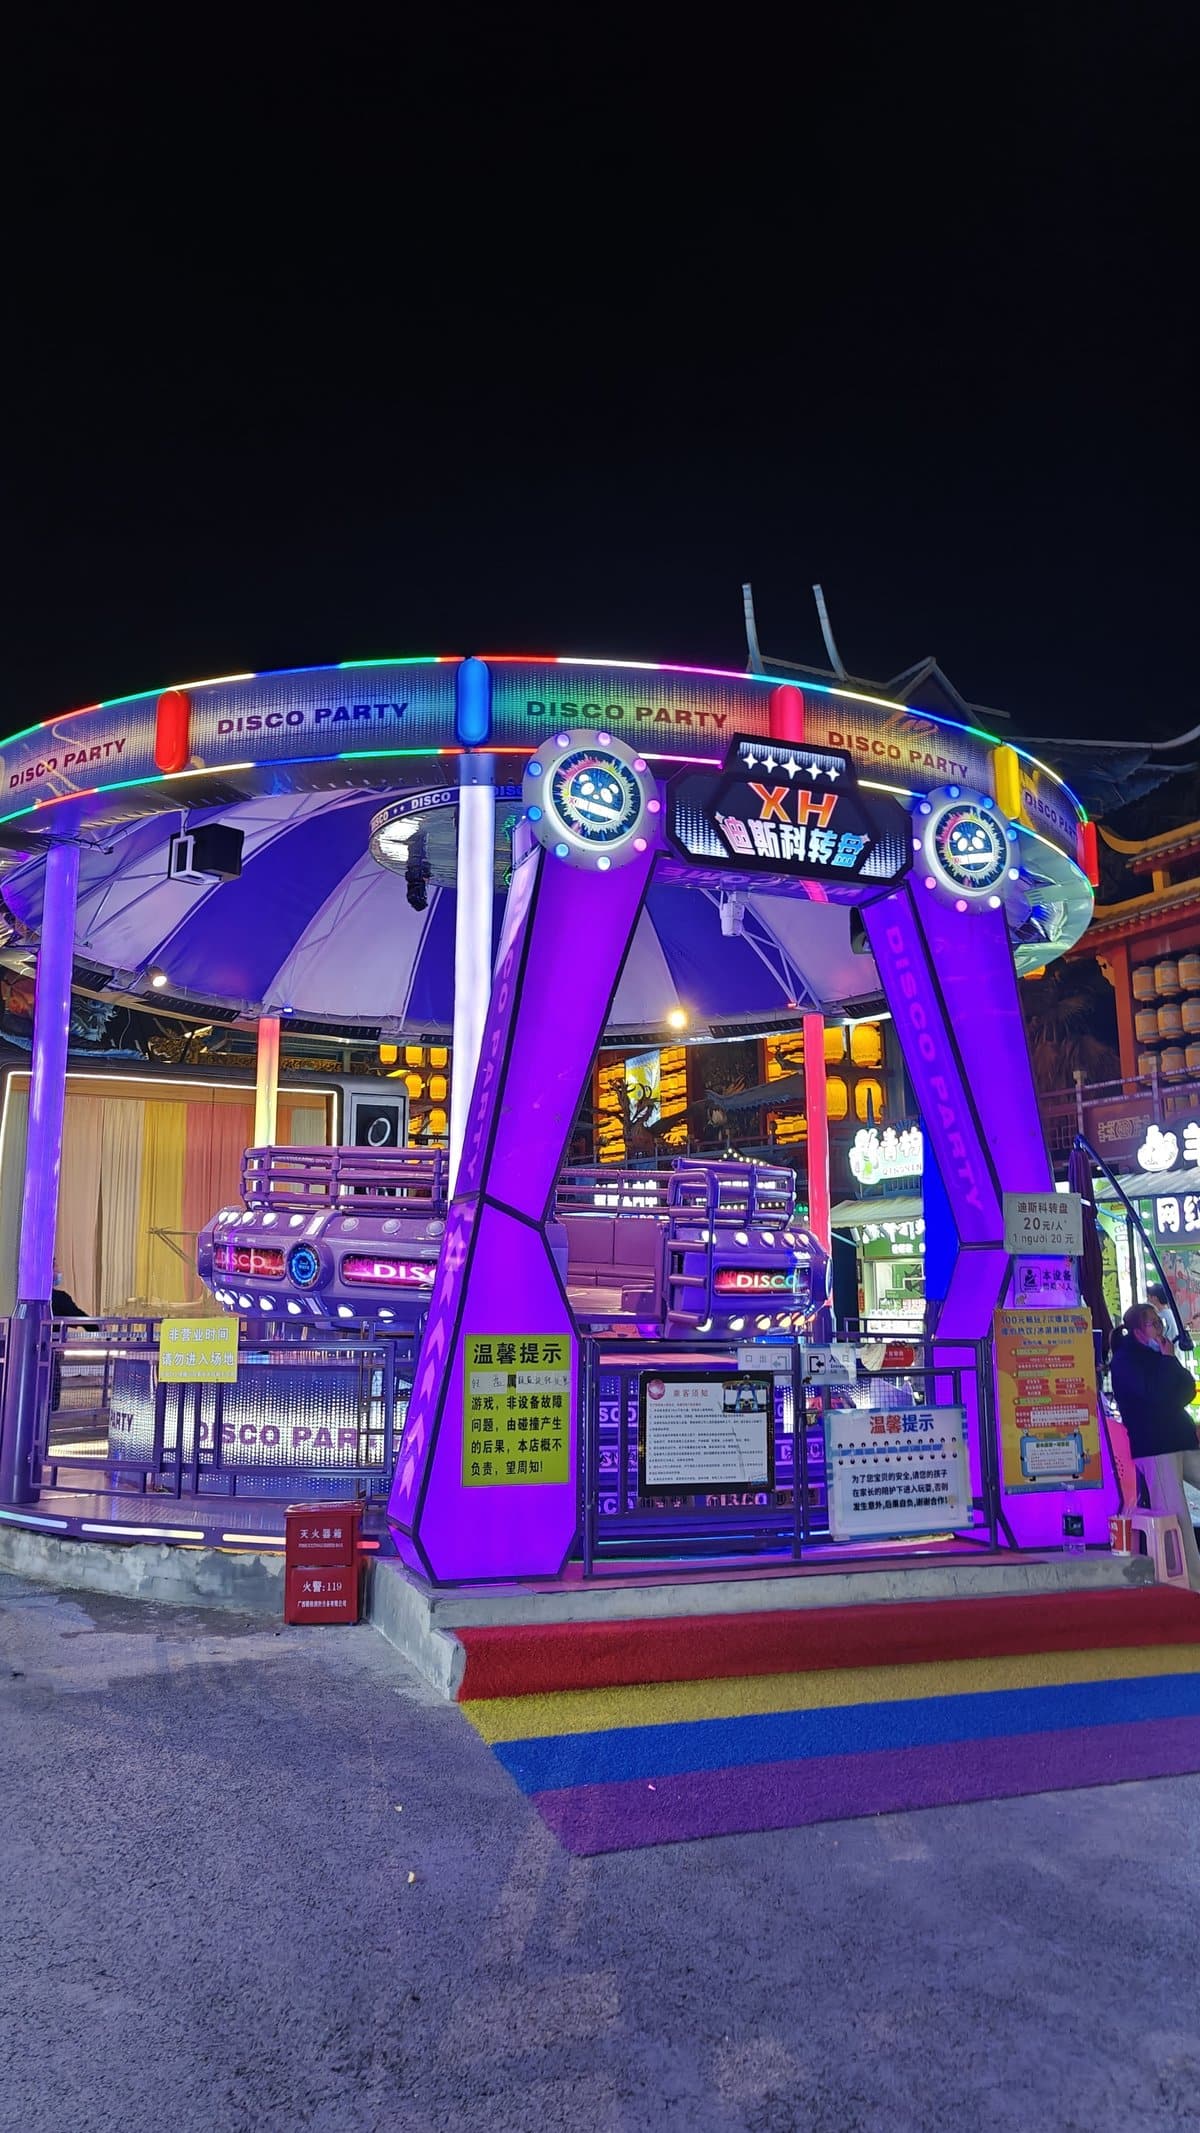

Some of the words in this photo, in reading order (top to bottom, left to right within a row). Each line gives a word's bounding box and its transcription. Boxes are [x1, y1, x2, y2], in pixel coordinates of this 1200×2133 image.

[217, 710, 304, 734] DISCO
[314, 703, 409, 723] PARTY
[527, 701, 624, 720] DISCO
[635, 707, 727, 729] PARTY
[9, 758, 57, 789] DISCO
[63, 739, 126, 768] PARTY
[828, 731, 900, 760] DISCO
[909, 750, 968, 779] PARTY
[411, 791, 451, 810] DISCO
[747, 782, 838, 828] XH
[1025, 791, 1057, 822] DISCO
[719, 815, 865, 868] 迪斯科转盘
[886, 925, 936, 1062] DISCO
[930, 1075, 984, 1211] PARTY
[1018, 1201, 1068, 1214] 迪斯科转盘
[1051, 1234, 1062, 1244] 20
[1065, 1233, 1074, 1244] 元
[220, 1252, 266, 1268] DISCO
[736, 1274, 799, 1289] DISCO
[169, 1327, 229, 1342] 非营业时间
[161, 1351, 235, 1367] 请勿进入场地
[473, 1342, 562, 1365] 温馨提示
[869, 1413, 935, 1435] 温馨提示
